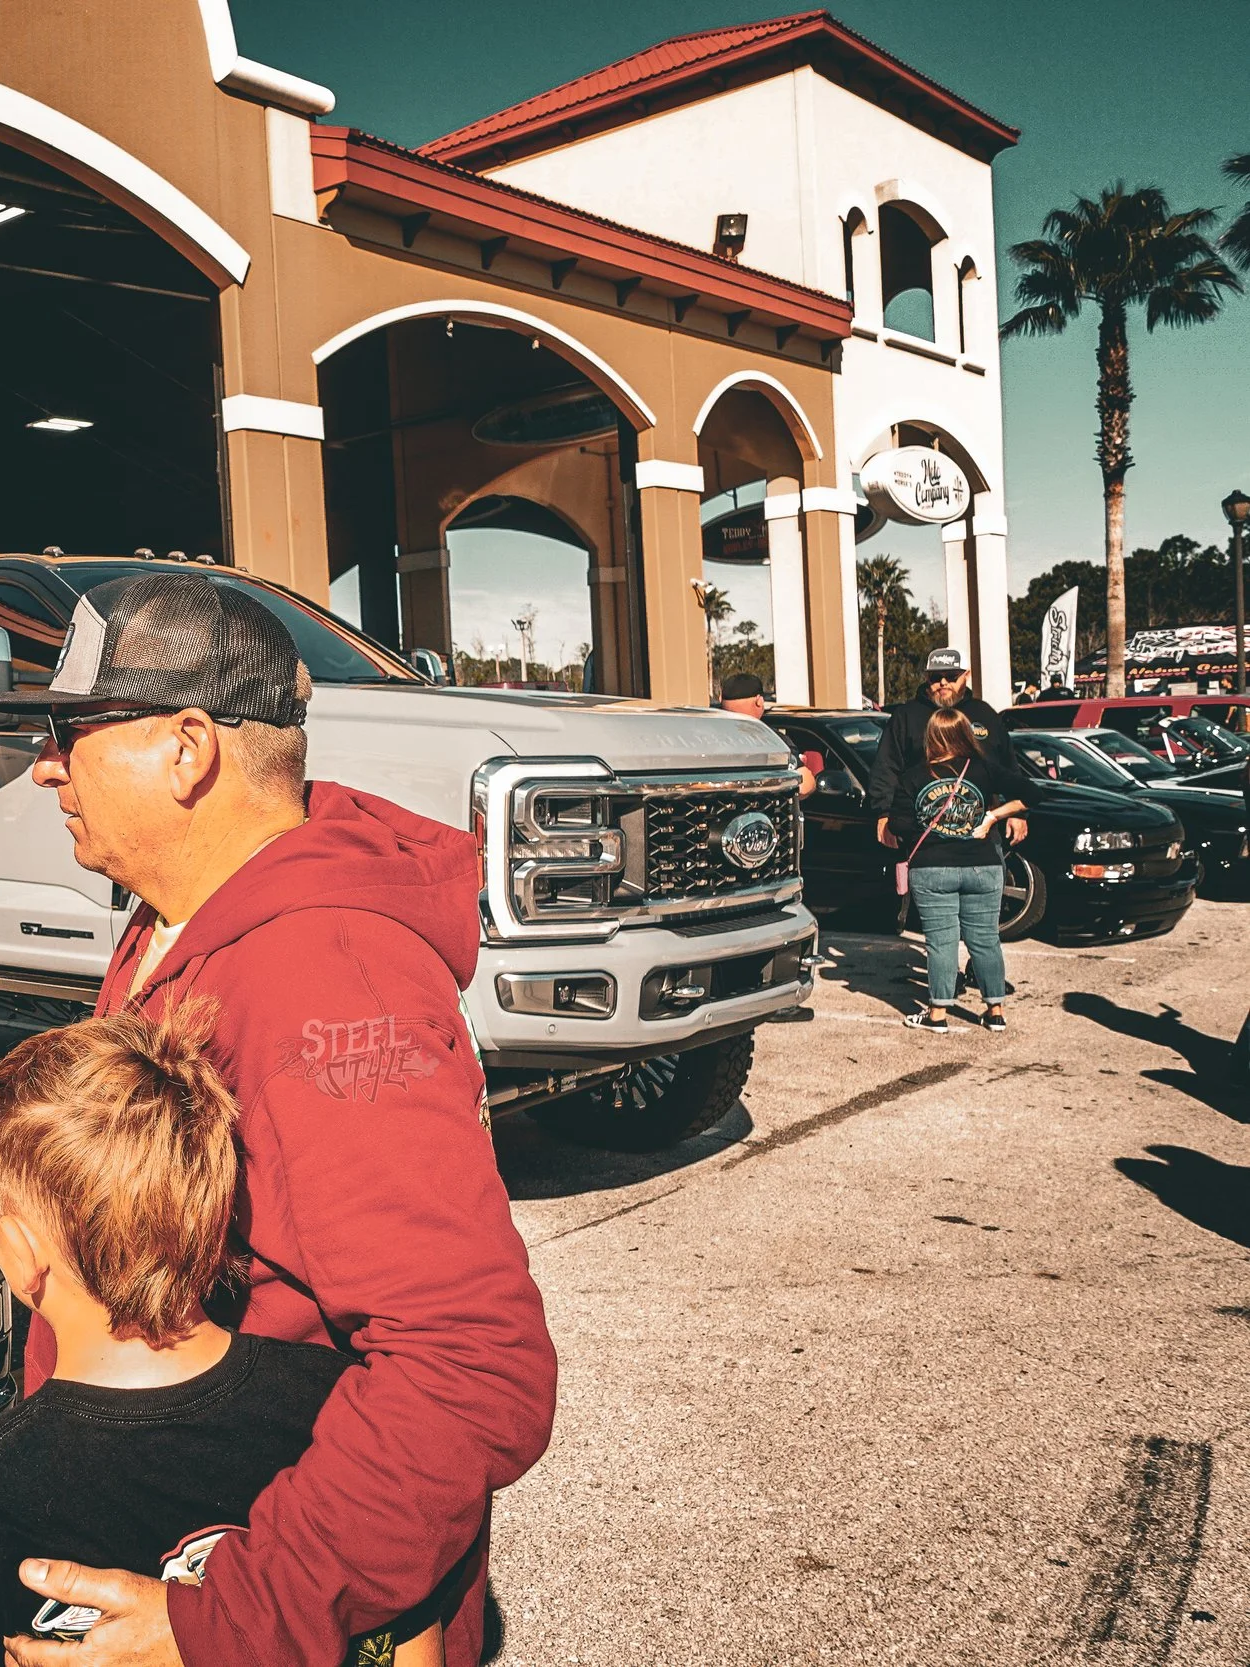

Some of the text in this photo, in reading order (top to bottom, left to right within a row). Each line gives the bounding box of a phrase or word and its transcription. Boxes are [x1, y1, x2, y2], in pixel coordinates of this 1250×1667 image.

[927, 784, 969, 801] QUALTY
[300, 1015, 412, 1060] STEEL
[325, 1044, 423, 1104] STYLE
